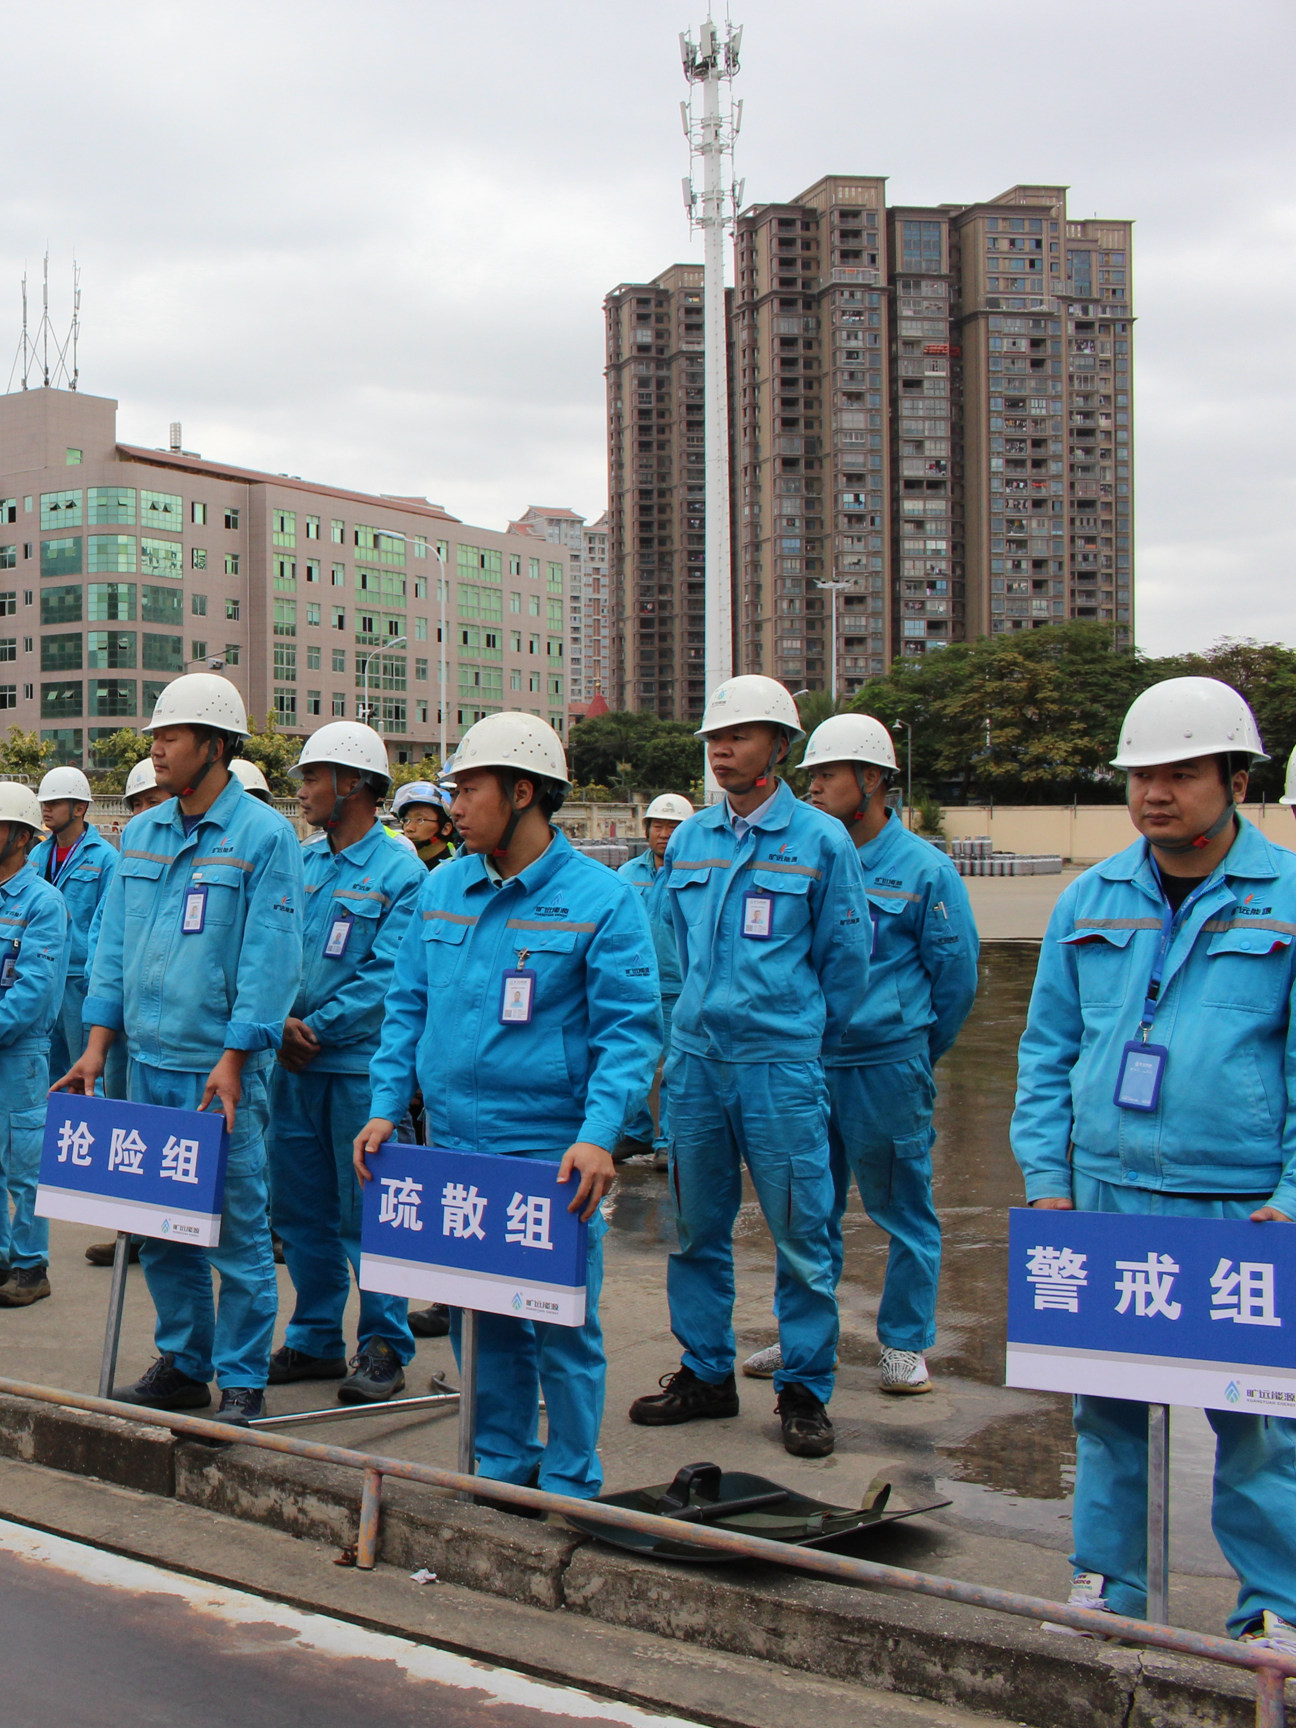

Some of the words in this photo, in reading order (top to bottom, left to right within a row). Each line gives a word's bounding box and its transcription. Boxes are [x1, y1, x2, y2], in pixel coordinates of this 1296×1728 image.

[57, 1119, 200, 1185] 抢险组
[378, 1176, 553, 1250] 疏散组
[1025, 1245, 1282, 1328] 警戒组
